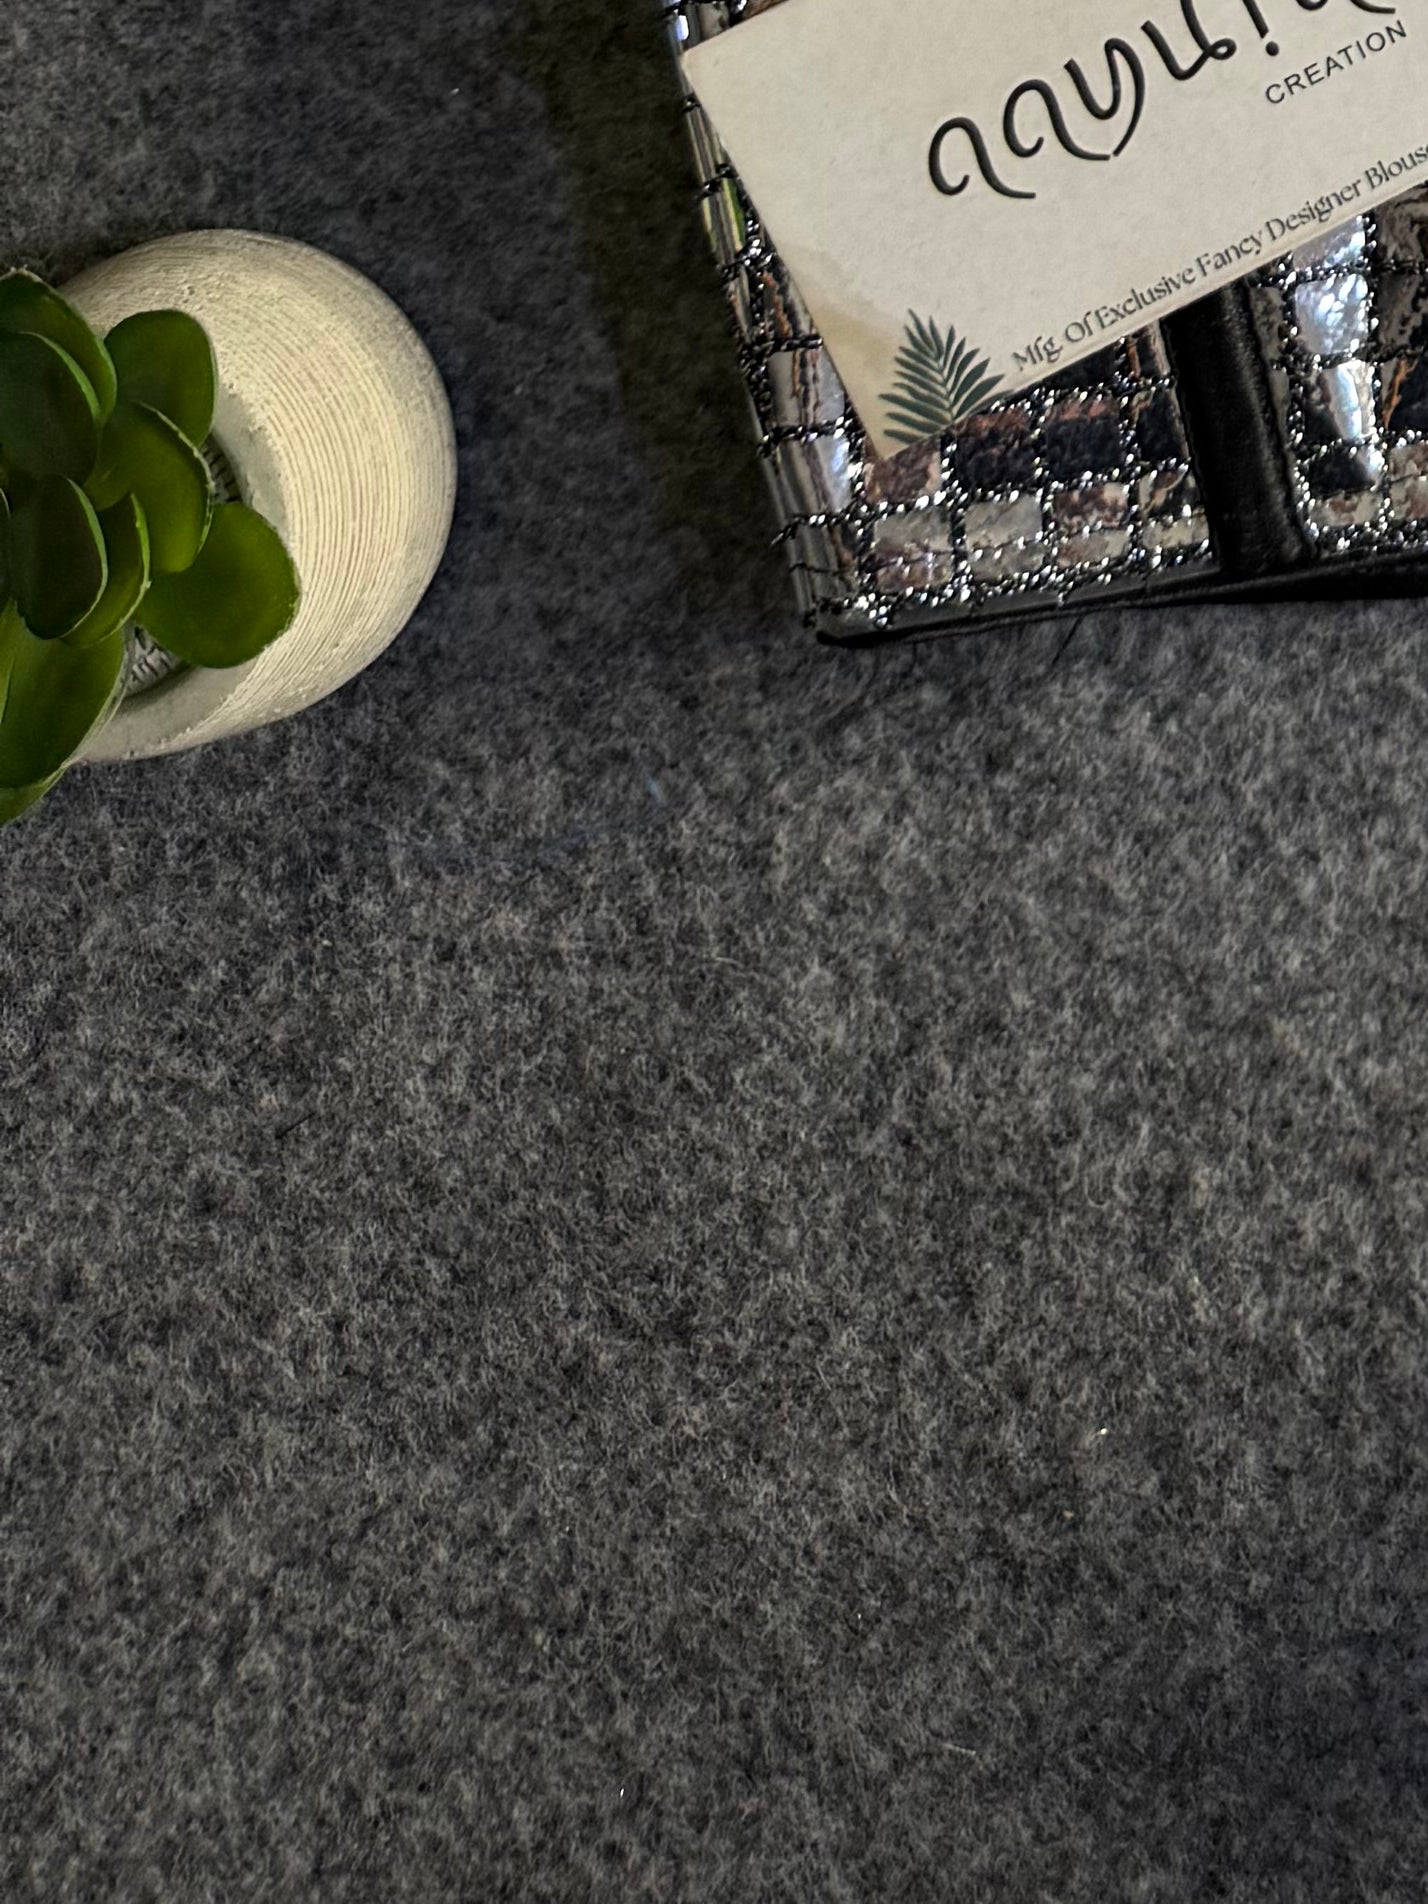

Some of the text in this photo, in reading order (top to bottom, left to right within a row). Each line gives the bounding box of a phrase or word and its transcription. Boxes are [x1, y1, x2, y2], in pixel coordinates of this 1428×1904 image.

[1264, 19, 1408, 105] CREATION
[1064, 310, 1094, 343] Of
[1093, 265, 1197, 331] Exclusive
[1195, 229, 1264, 278] Fancy
[1264, 177, 1363, 240] Designer
